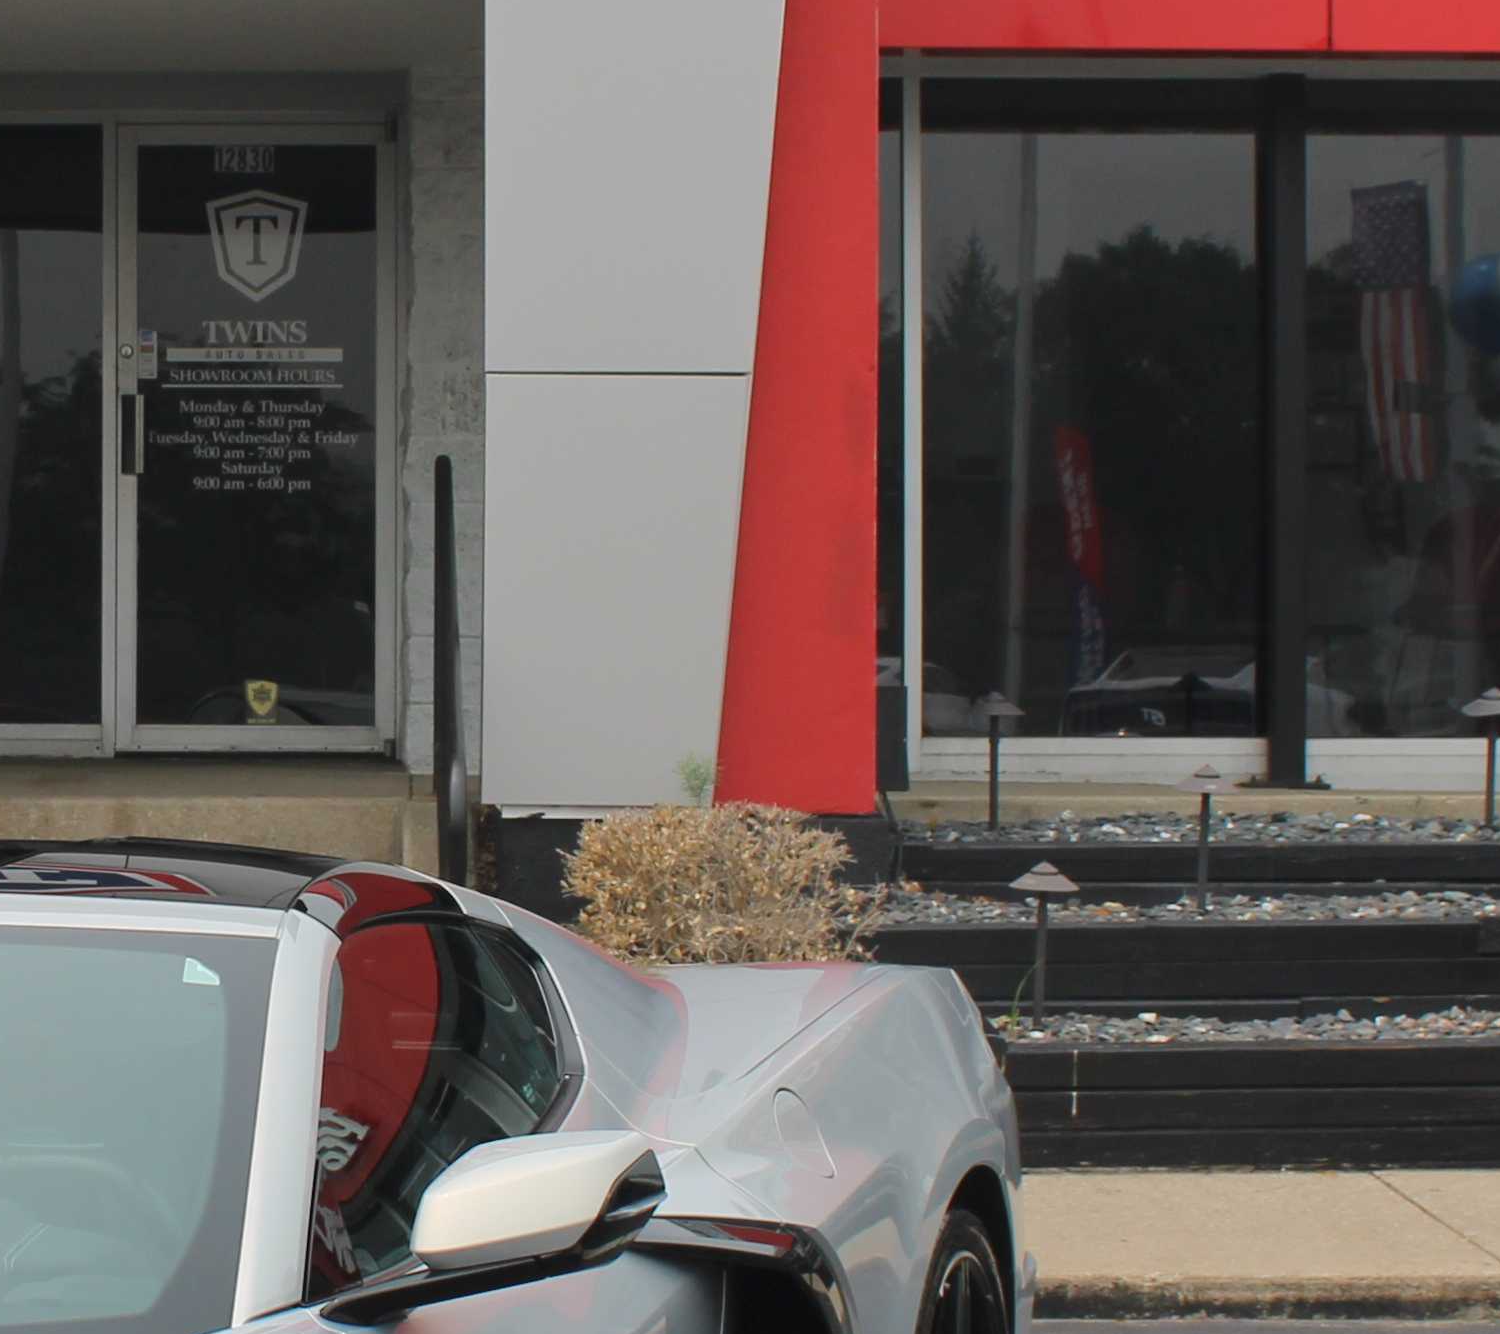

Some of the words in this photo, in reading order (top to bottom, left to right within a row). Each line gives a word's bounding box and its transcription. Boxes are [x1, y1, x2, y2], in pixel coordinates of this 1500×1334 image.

[214, 146, 274, 172] 12830
[235, 215, 279, 266] T
[202, 320, 308, 344] TWINS
[169, 369, 272, 383] SHOWROOM
[277, 369, 336, 383] HOURS
[179, 400, 238, 415] Monday
[242, 400, 255, 414] &
[259, 400, 326, 415] Thursday
[192, 416, 221, 428] 9:00
[223, 418, 246, 428] am
[257, 416, 285, 428] 8:00
[288, 418, 312, 431] pm
[212, 431, 292, 445] Wednesday
[297, 431, 310, 444] &
[314, 431, 359, 445] Friday
[192, 447, 221, 459] 9:00
[223, 449, 246, 459] am
[257, 447, 285, 459] 7:00
[288, 449, 312, 462] pm
[221, 461, 284, 476] Saturday
[192, 478, 221, 490] 9:00
[223, 480, 246, 490] am
[257, 478, 285, 490] 6:00
[288, 480, 312, 493] pm
